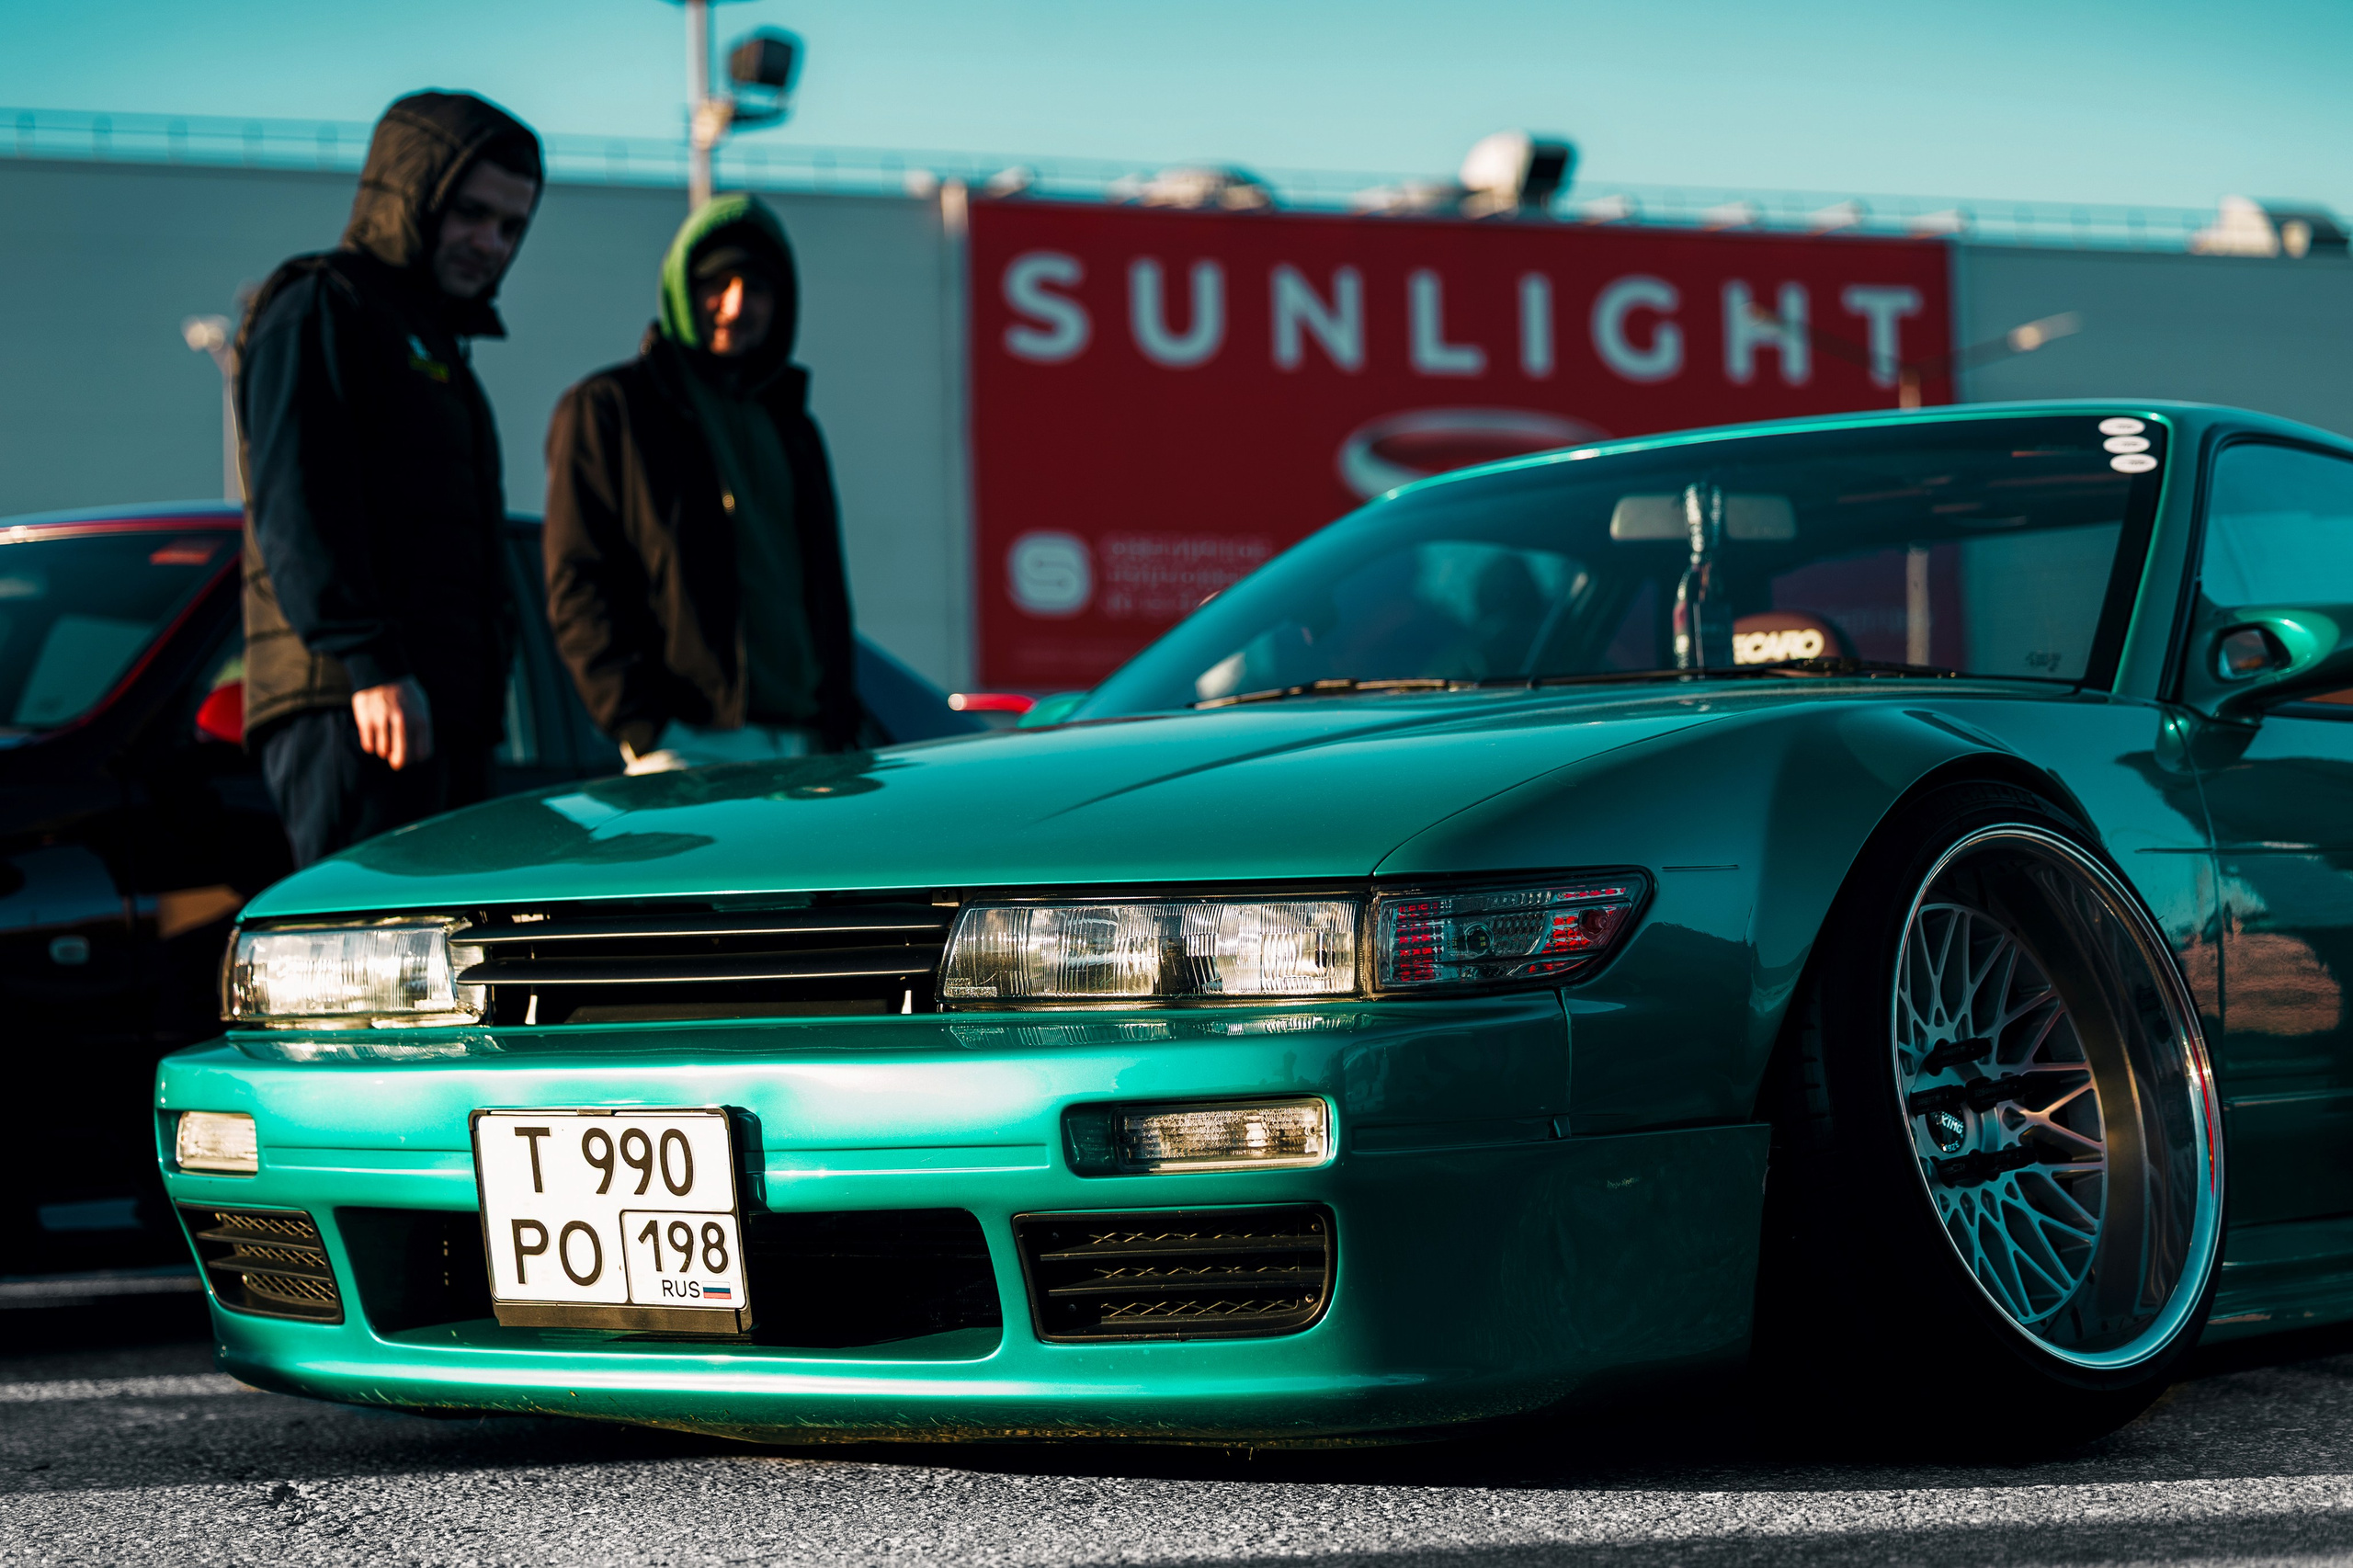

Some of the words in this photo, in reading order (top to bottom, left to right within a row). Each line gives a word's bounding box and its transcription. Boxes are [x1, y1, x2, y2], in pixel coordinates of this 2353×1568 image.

[1003, 251, 1923, 386] SUNLIGHT
[514, 1126, 551, 1193] T
[581, 1127, 694, 1197] 990
[511, 1218, 603, 1287] PO
[638, 1219, 729, 1274] 198
[662, 1278, 700, 1298] RUS
